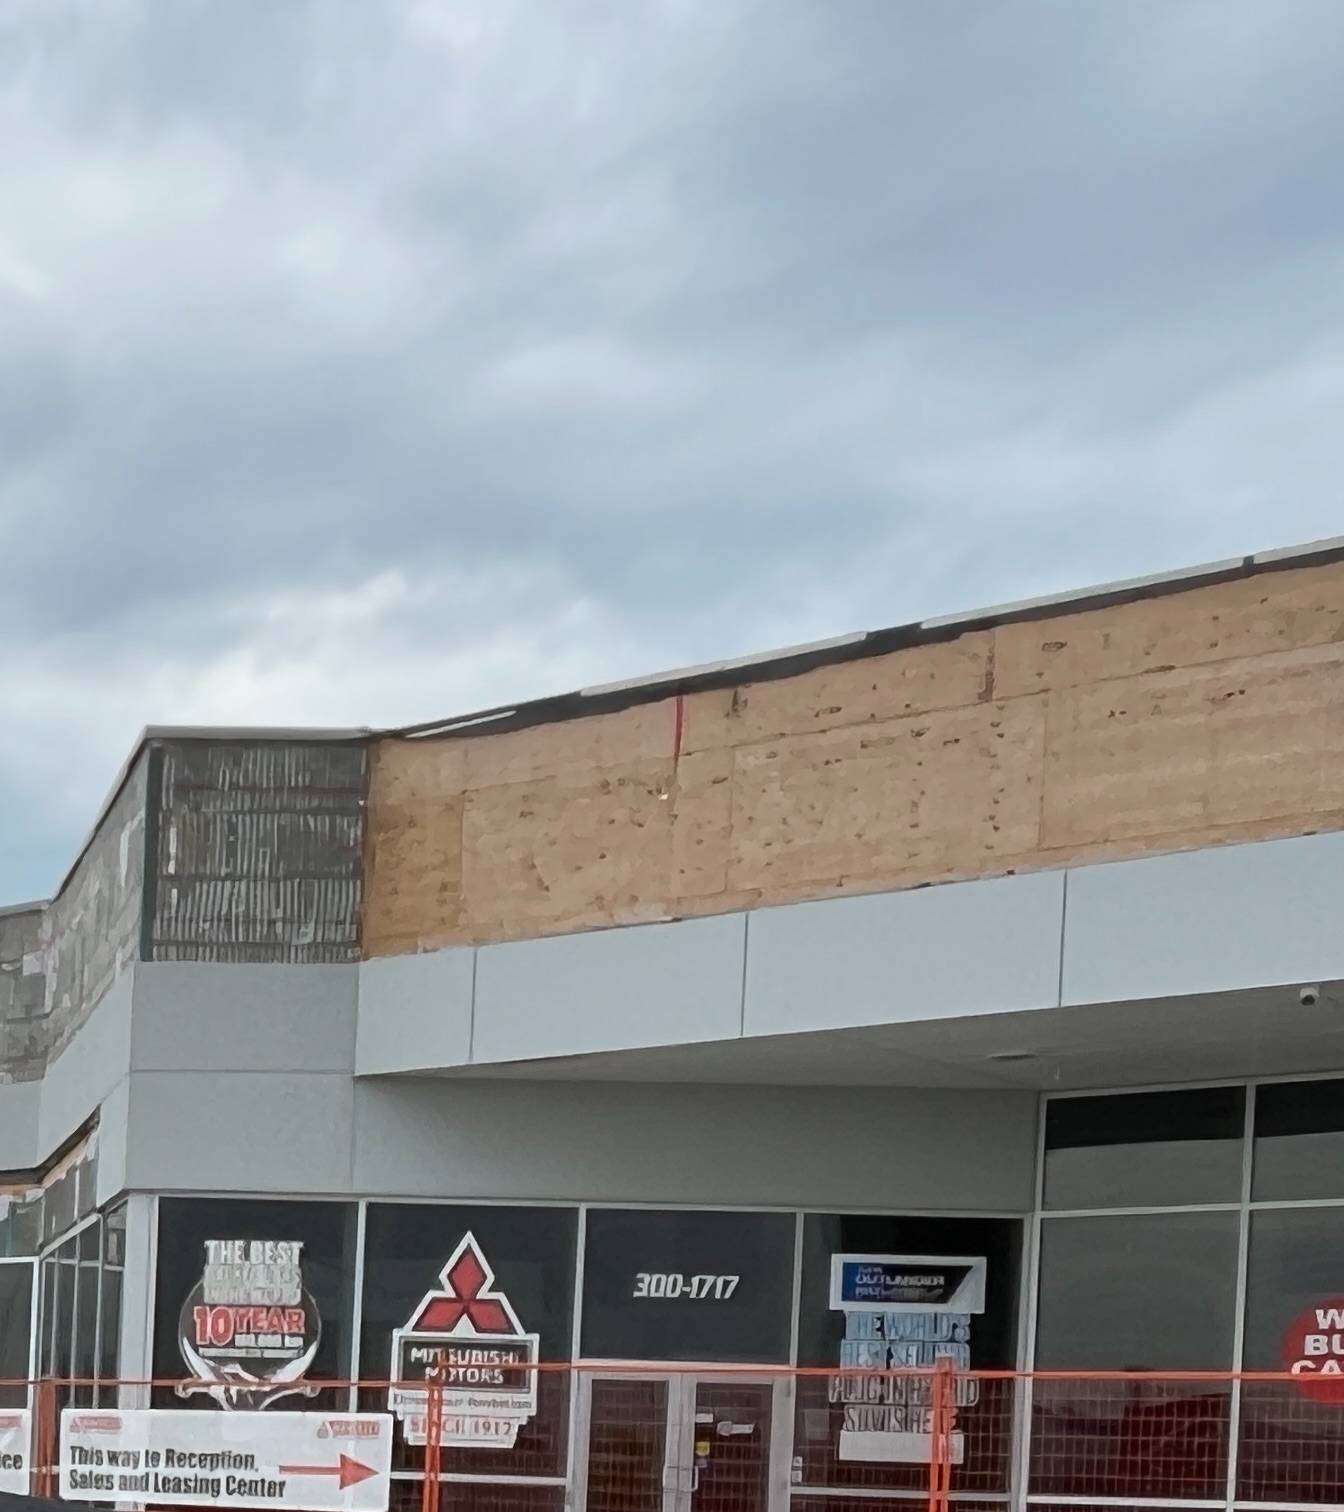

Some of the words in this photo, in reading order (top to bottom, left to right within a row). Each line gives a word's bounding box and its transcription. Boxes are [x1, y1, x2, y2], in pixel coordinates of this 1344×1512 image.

[204, 1240, 245, 1265] THE
[250, 1240, 304, 1265] BEST
[633, 1273, 739, 1299] 300-1717
[194, 1306, 234, 1345] 10
[235, 1307, 305, 1334] YEAR
[1315, 1309, 1344, 1329] W
[1304, 1334, 1344, 1355] BU
[1291, 1360, 1344, 1378] CA
[69, 1446, 104, 1466] This
[108, 1449, 140, 1469] way
[144, 1448, 161, 1468] to
[69, 1469, 113, 1491] Sales
[118, 1472, 150, 1492] and
[153, 1472, 220, 1498] Leasing
[225, 1475, 287, 1498] Center
